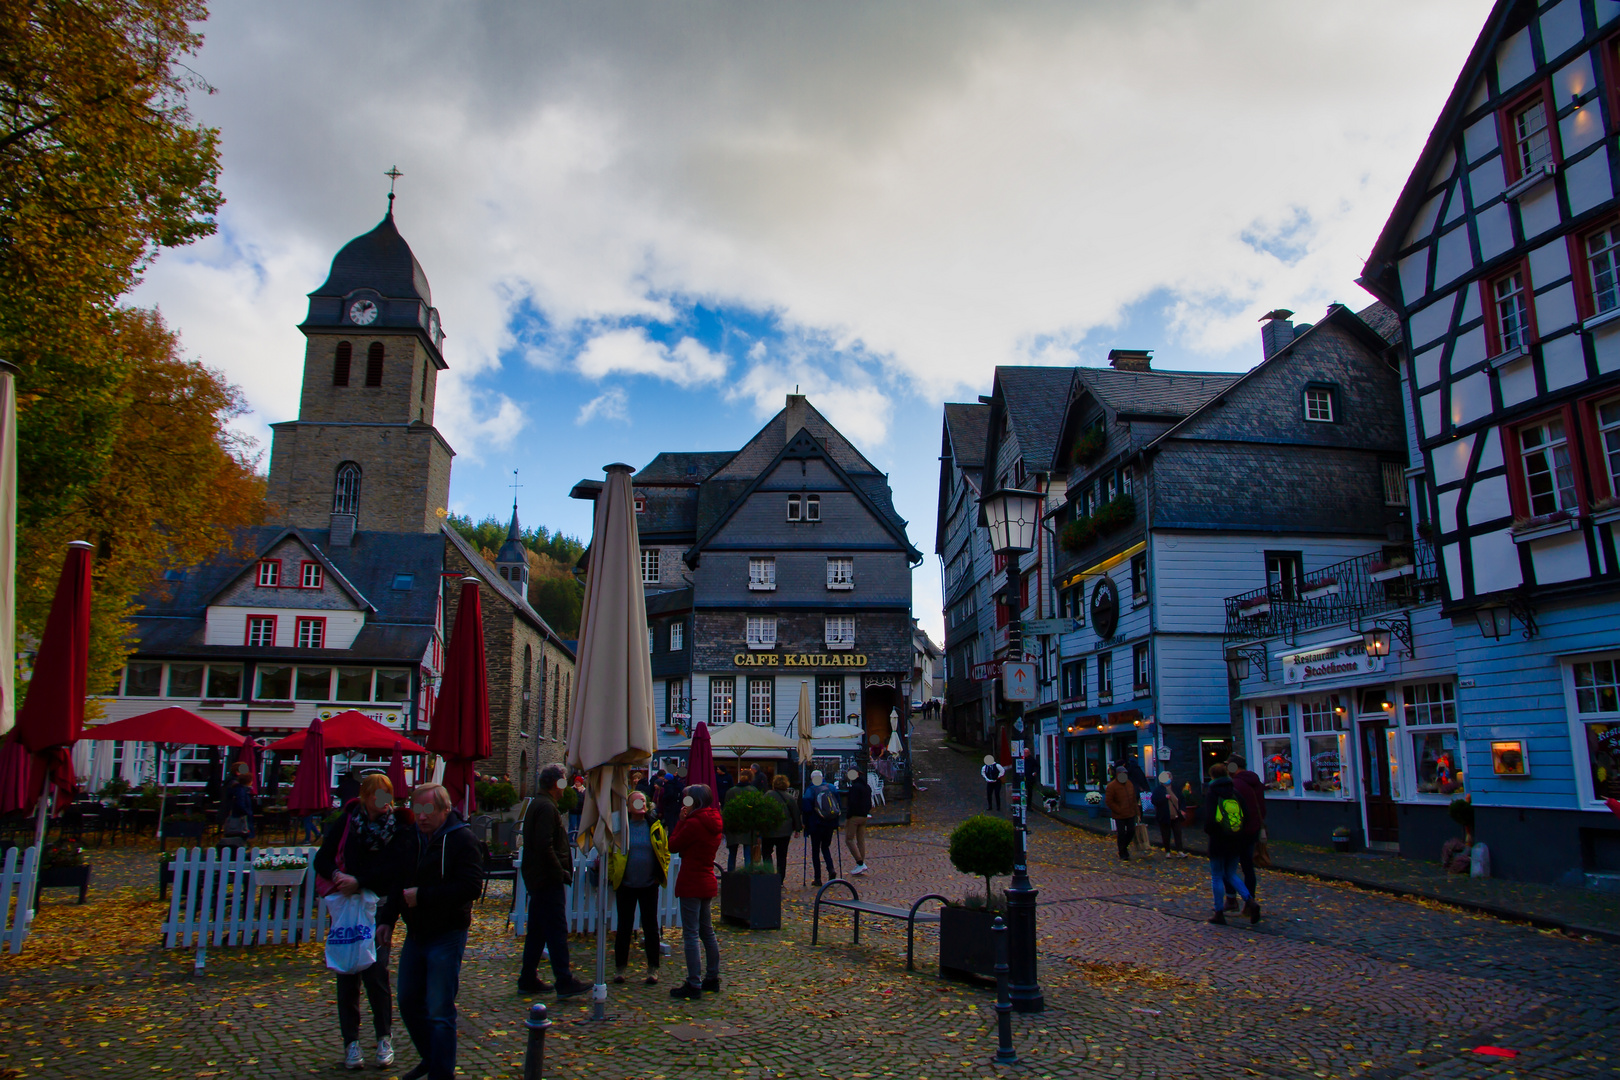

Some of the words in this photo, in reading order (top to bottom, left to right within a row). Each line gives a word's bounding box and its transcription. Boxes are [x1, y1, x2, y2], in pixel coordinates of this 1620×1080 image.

[733, 653, 779, 667] CAFE
[783, 653, 868, 667] KAULARD
[986, 663, 997, 676] WC
[1303, 661, 1358, 680] Stadtkrone
